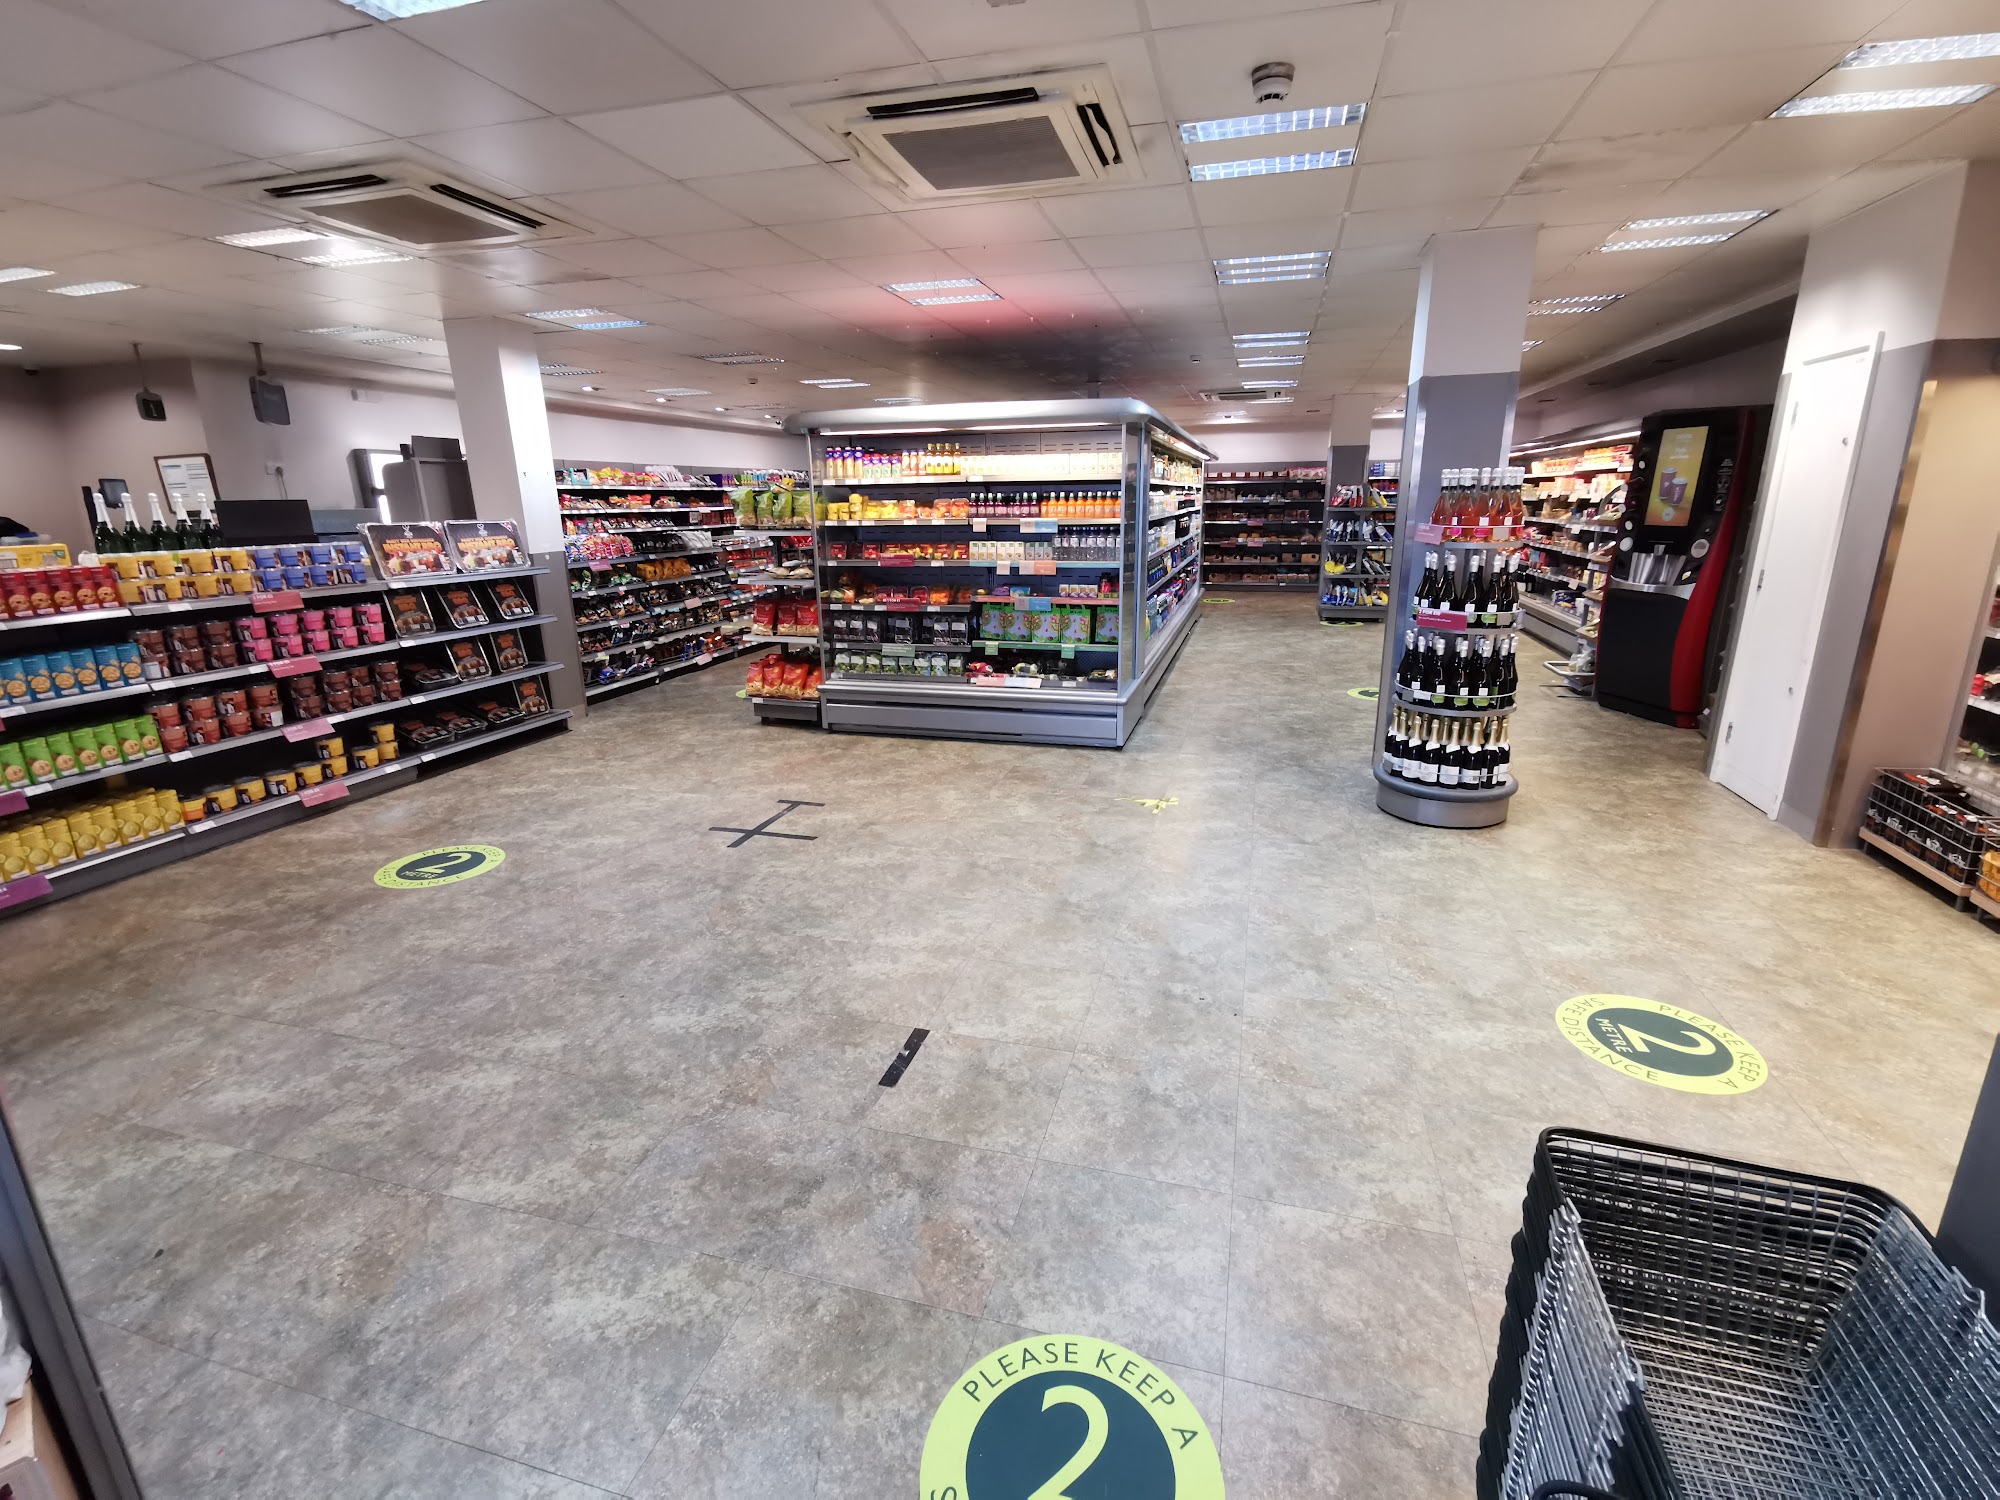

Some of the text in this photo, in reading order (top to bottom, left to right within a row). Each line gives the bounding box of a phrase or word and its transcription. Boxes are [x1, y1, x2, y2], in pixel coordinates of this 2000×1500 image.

[401, 870, 437, 880] METRE
[415, 852, 472, 874] 2
[1562, 997, 1659, 1082] SAFE DISTANCE
[1595, 1018, 1633, 1054] METRE
[1616, 1023, 1717, 1055] 2
[1659, 1005, 1761, 1089] PLEASE KEEP A
[962, 1342, 1199, 1450] PLEASE KEEP A
[1027, 1385, 1109, 1500] 2
